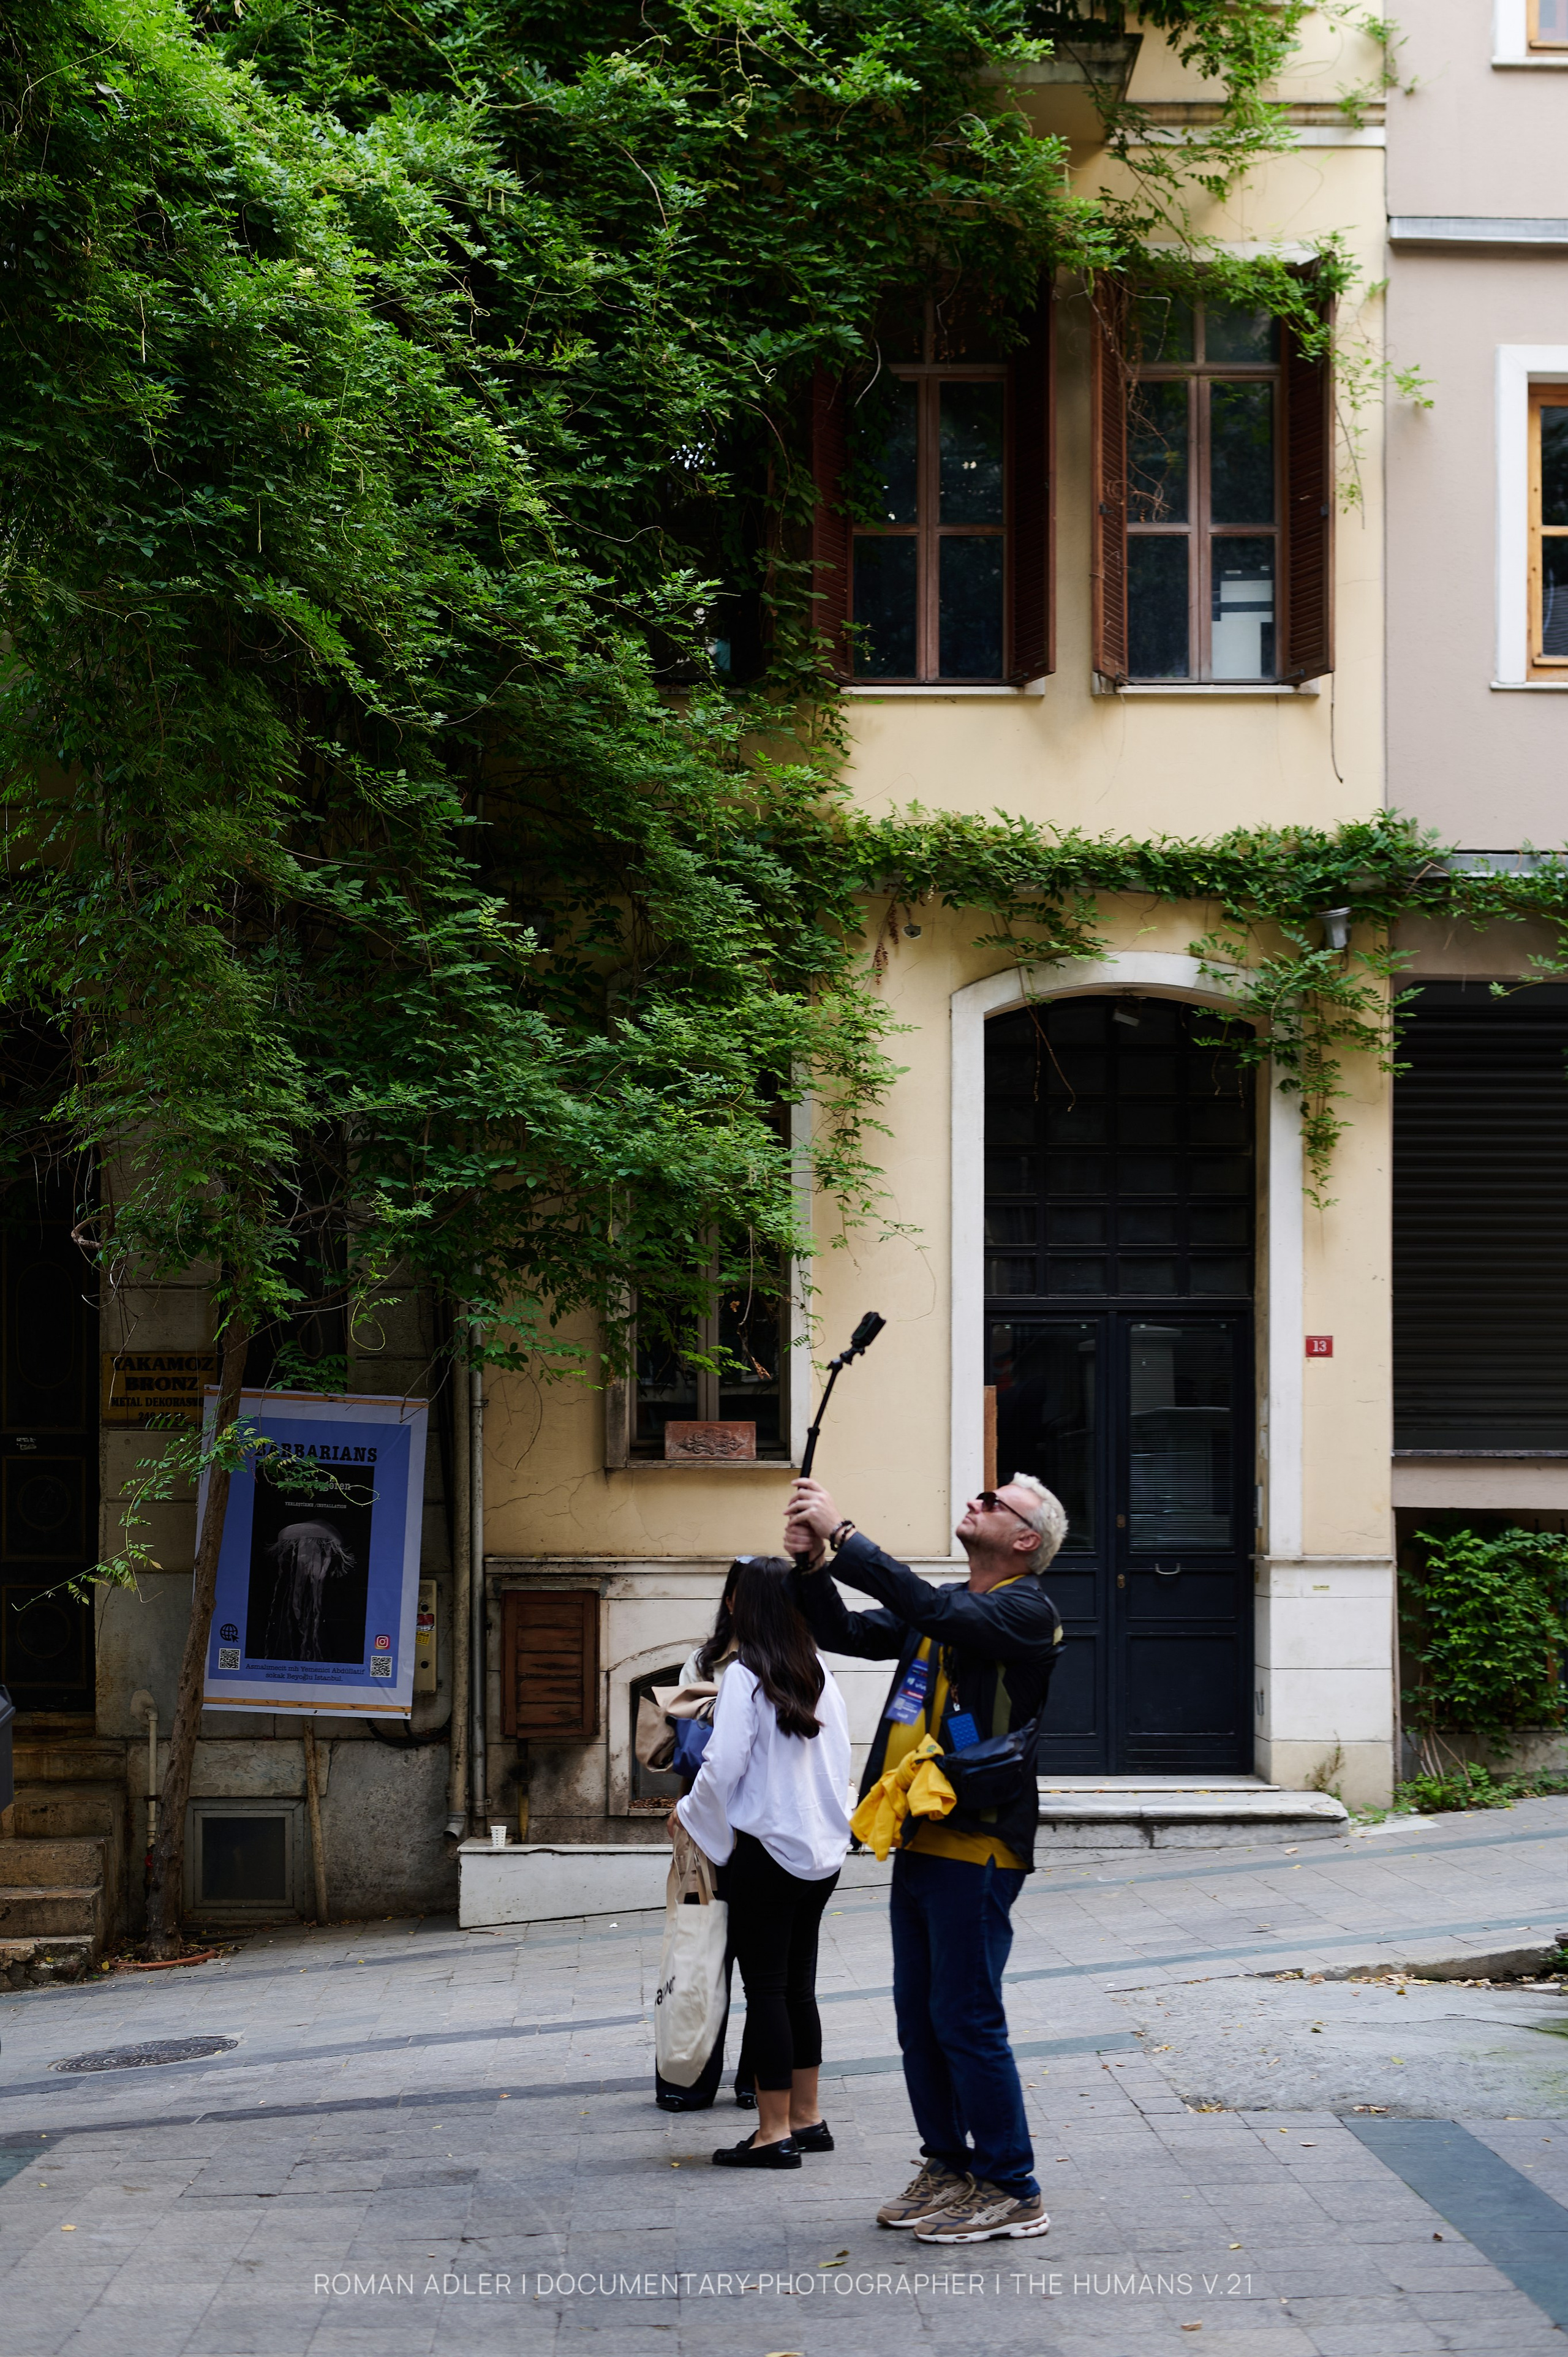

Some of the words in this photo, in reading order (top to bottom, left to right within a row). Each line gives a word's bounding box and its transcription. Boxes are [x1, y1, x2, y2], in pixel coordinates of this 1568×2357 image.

[1313, 1340, 1327, 1352] 13
[110, 1356, 214, 1371] YAKAMOZ
[125, 1376, 200, 1391] BRONZ
[112, 1397, 142, 1406] METAL
